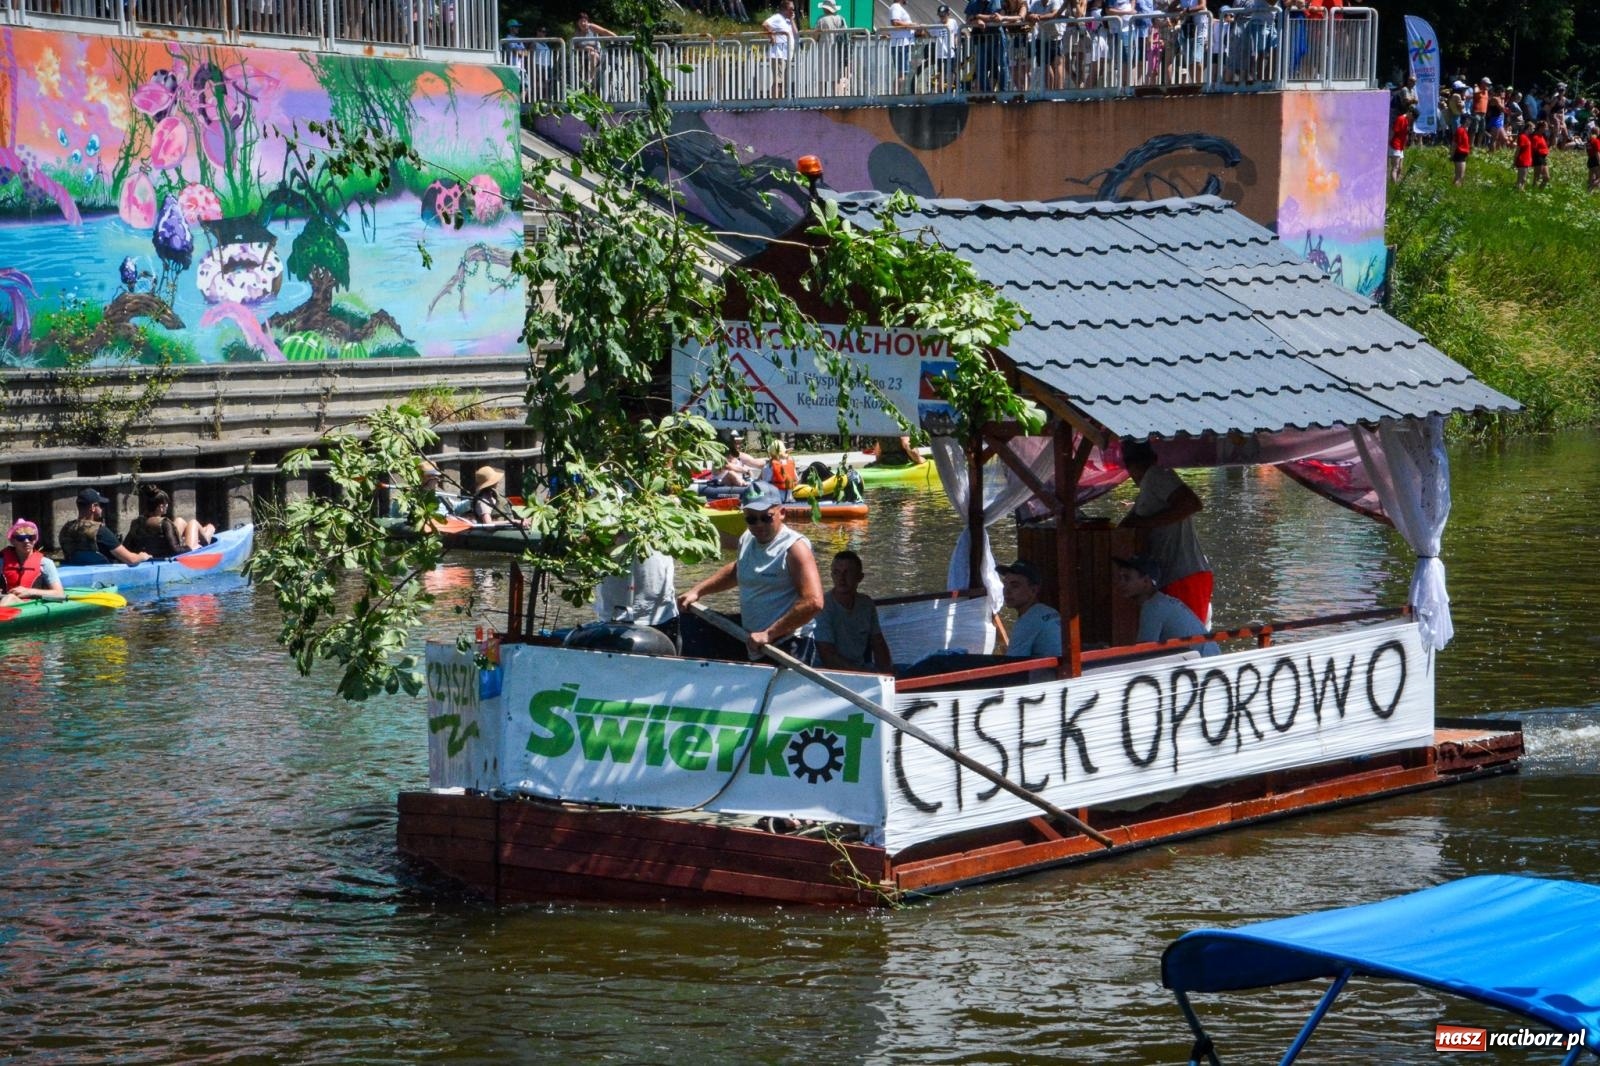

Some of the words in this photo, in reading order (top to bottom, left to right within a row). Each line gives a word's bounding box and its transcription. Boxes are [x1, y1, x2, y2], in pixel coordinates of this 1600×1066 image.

[786, 371, 800, 386] ul.
[888, 376, 903, 391] 23
[894, 687, 1099, 813] CISEK
[1121, 639, 1407, 773] OPOROWO
